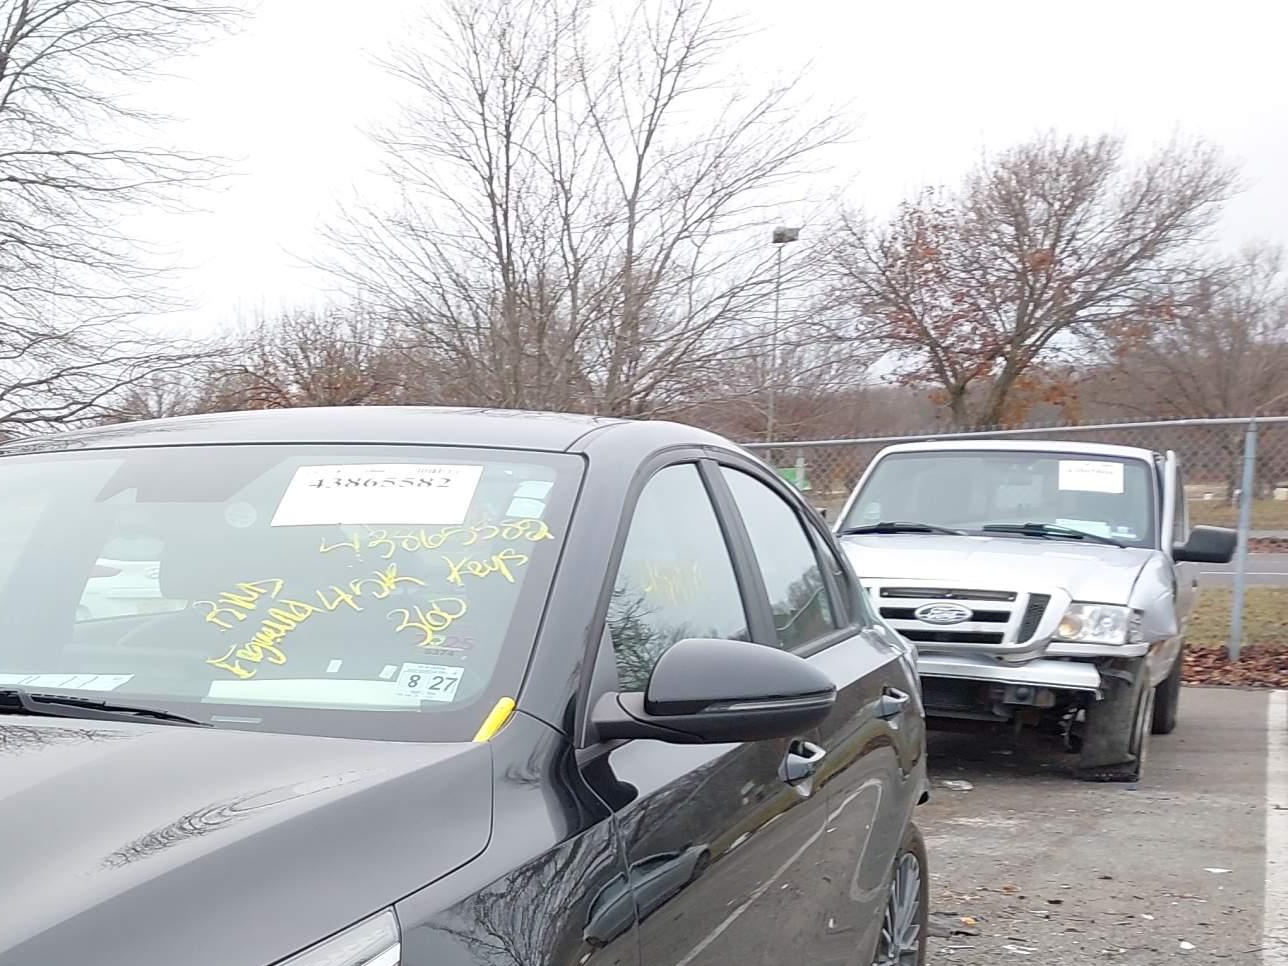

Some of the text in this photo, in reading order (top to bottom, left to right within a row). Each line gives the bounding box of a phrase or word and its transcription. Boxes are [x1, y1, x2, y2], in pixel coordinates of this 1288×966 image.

[308, 477, 453, 489] 43865582
[407, 674, 459, 692] 8 27
